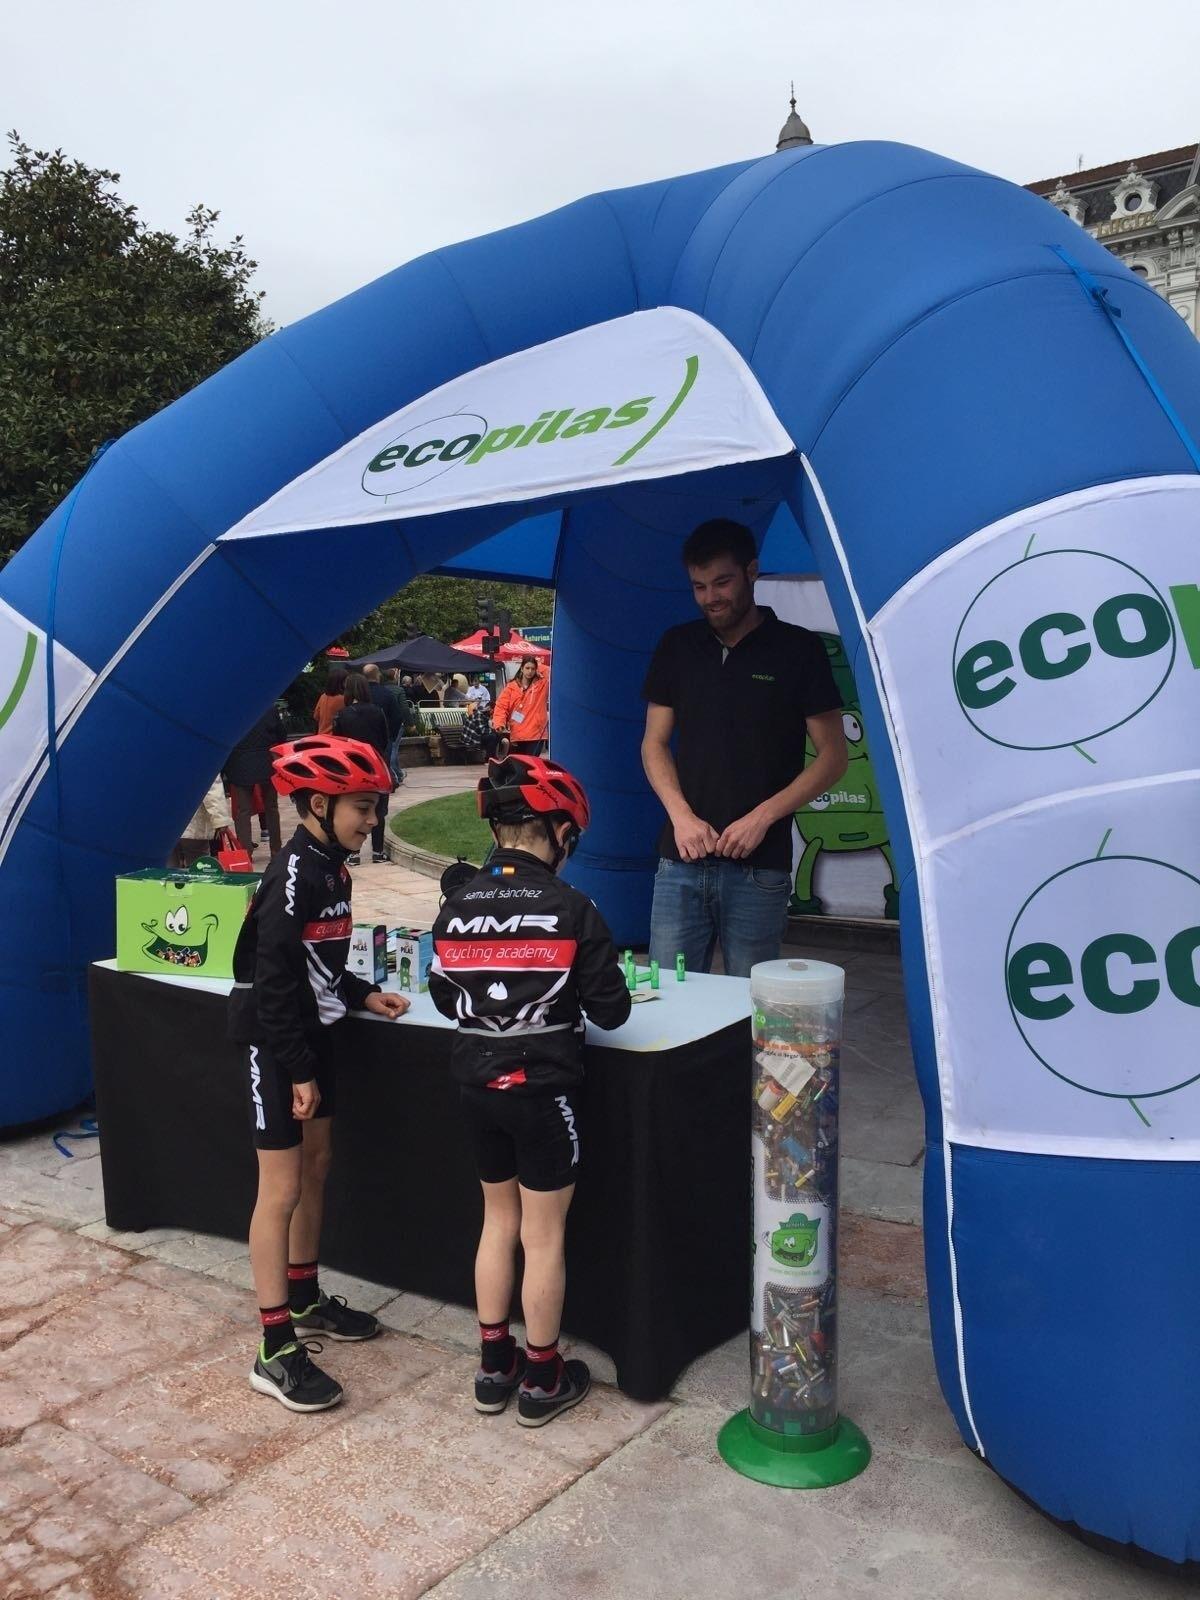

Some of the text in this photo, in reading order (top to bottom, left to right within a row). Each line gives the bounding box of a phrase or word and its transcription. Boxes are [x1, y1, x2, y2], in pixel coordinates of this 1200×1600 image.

[368, 396, 657, 473] ecopilas
[815, 791, 867, 805] copilas
[285, 853, 301, 916] MMR
[463, 887, 543, 900] samuel sánchez
[320, 901, 352, 918] MM
[446, 914, 559, 934] MMR
[445, 944, 559, 962] cycling academy
[249, 1044, 266, 1130] MMR
[554, 1095, 580, 1168] MMR
